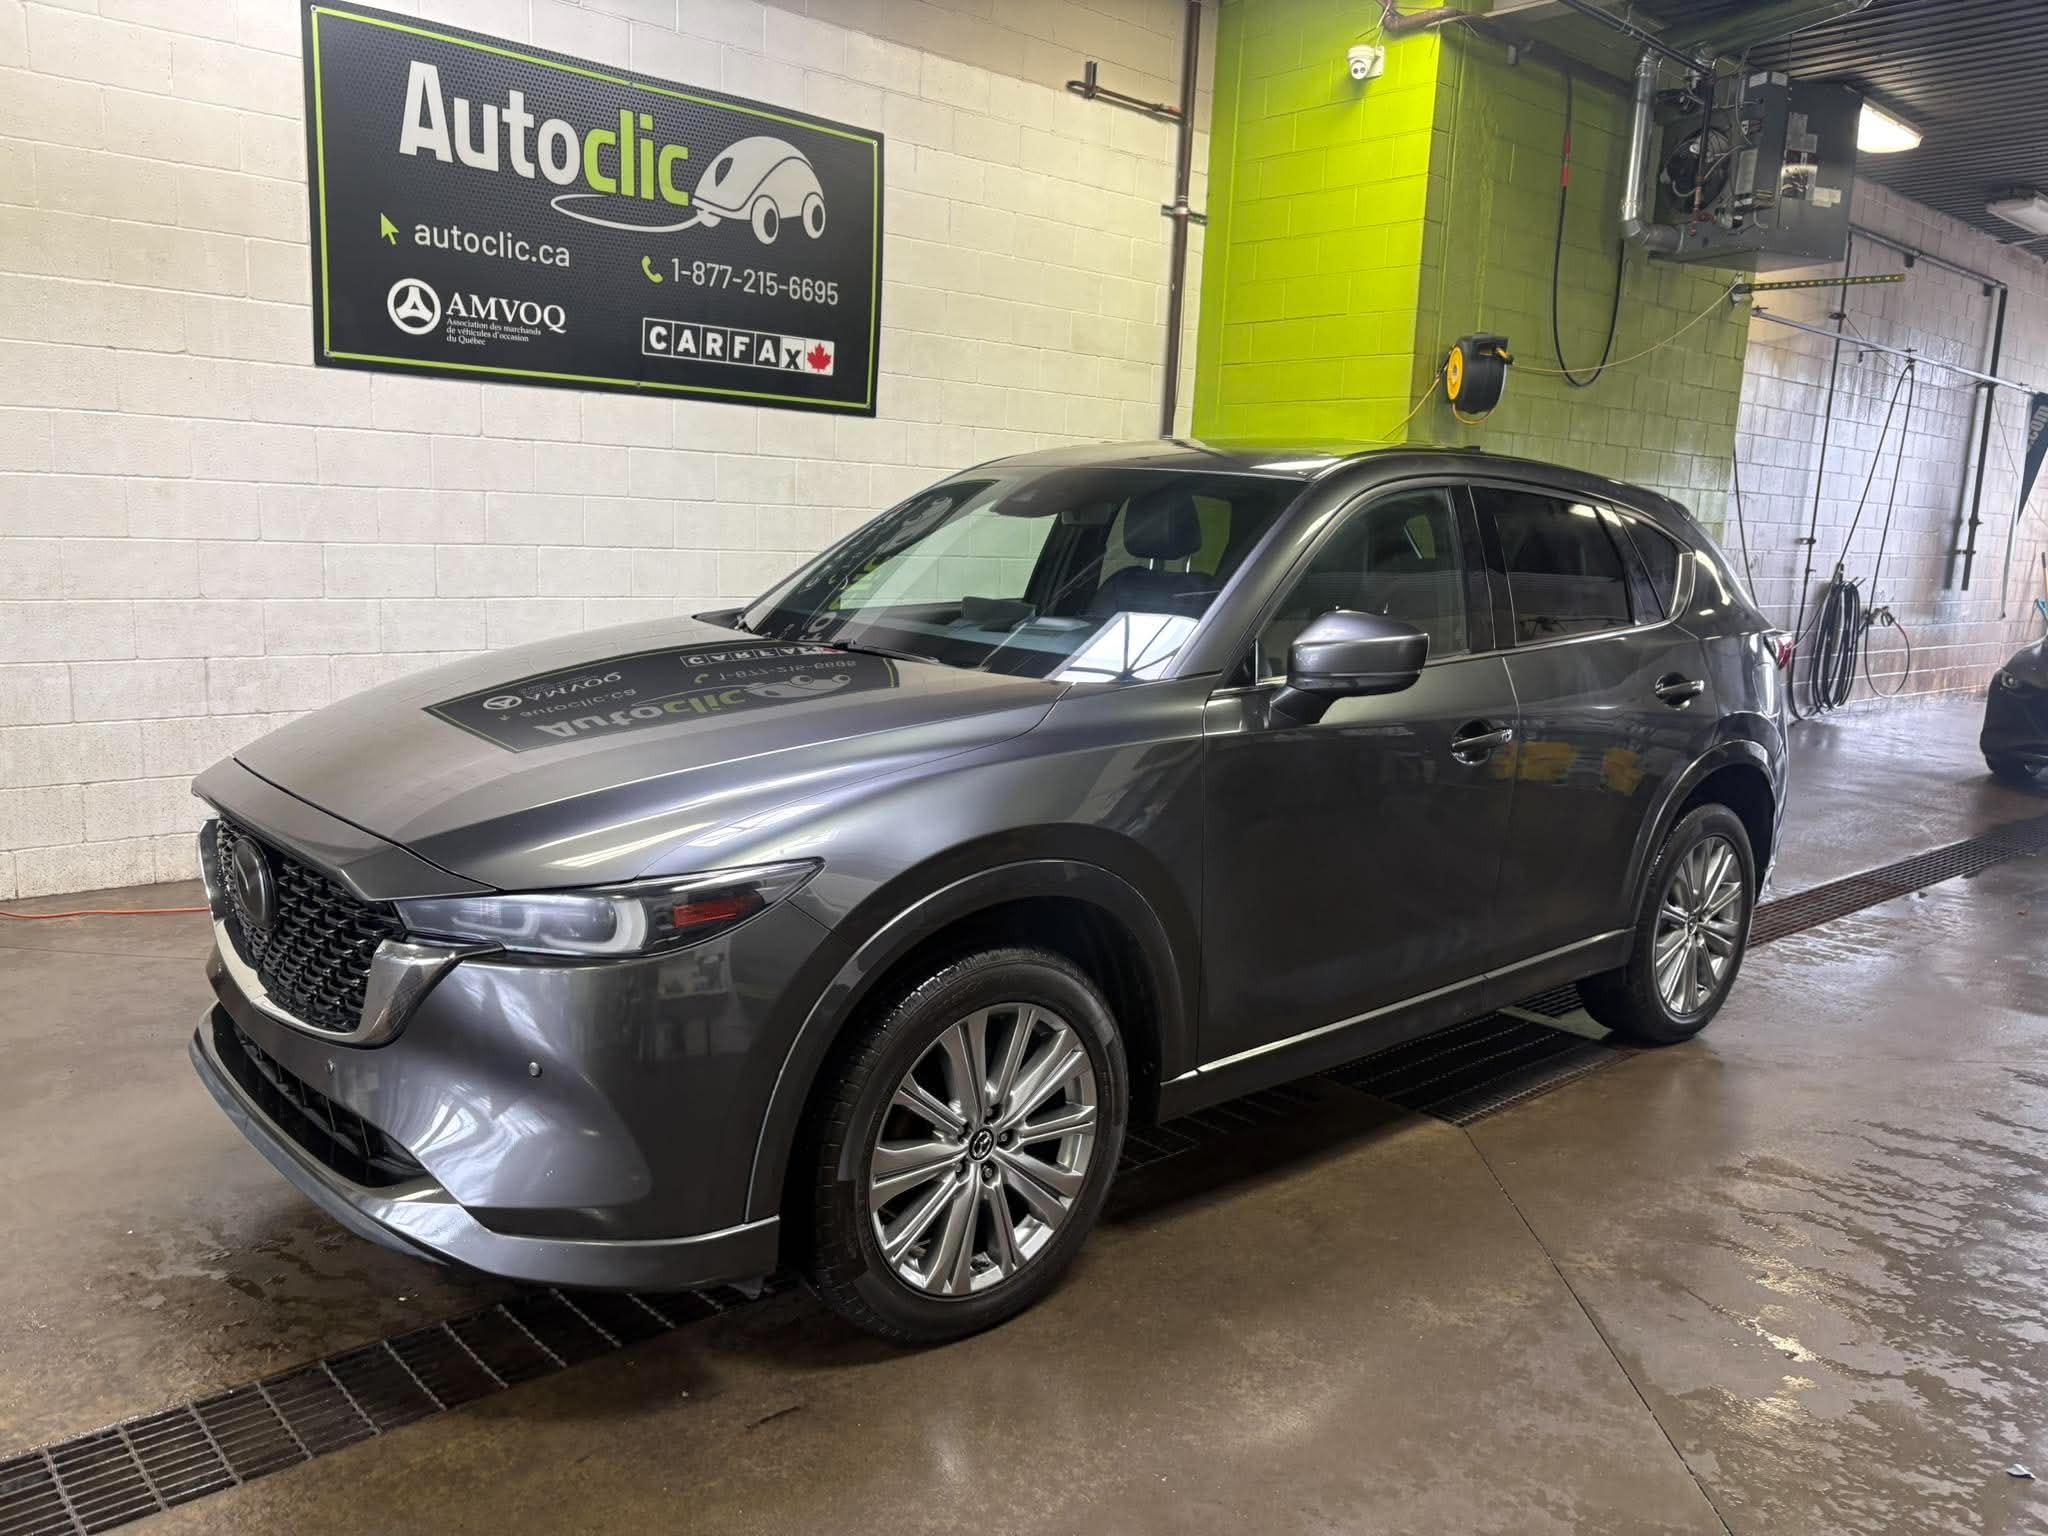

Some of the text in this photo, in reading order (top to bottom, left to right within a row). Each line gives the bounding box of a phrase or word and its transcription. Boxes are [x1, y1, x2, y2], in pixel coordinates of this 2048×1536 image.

[399, 59, 689, 206] Autoclic
[414, 223, 570, 267] autoclic.ca
[671, 257, 839, 305] 1-877-215-6695
[446, 292, 567, 334] AMVOQ
[446, 318, 541, 336] Association des marchands
[446, 325, 456, 334] de
[457, 327, 491, 338] véhicules
[446, 333, 486, 346] du Québec
[649, 325, 803, 370] CARFAX
